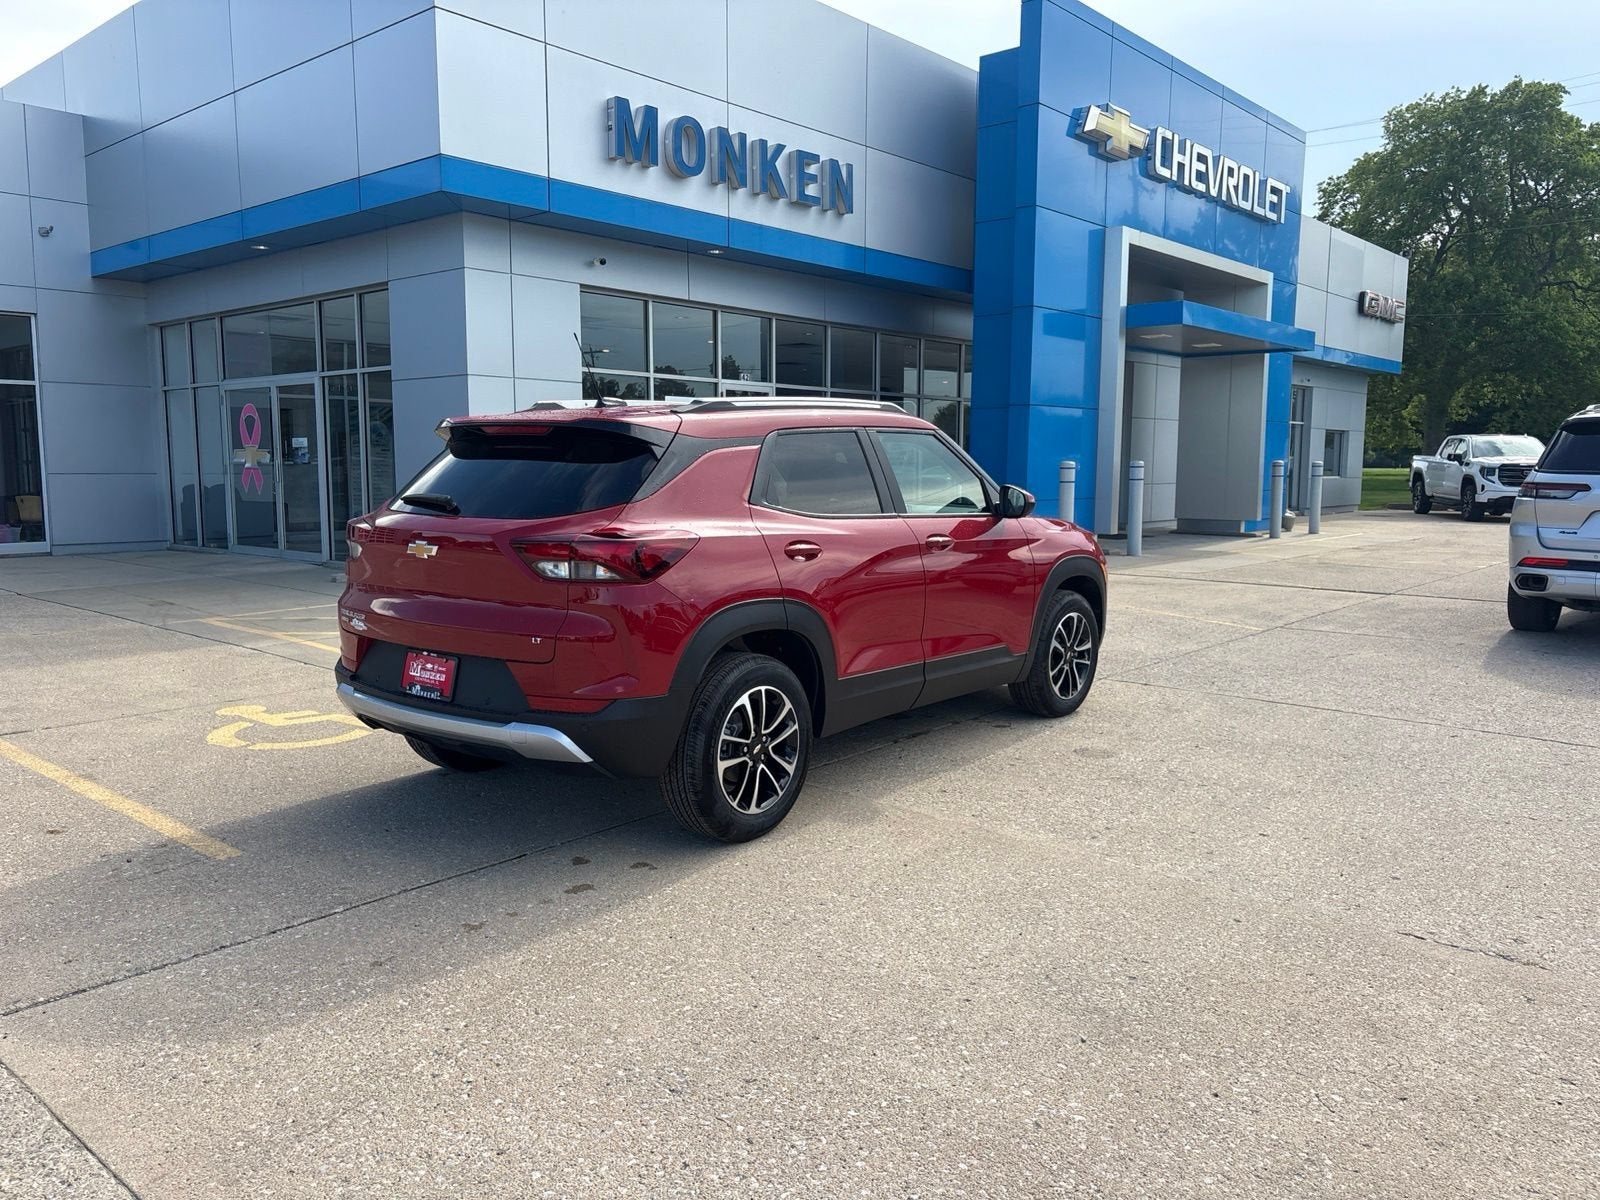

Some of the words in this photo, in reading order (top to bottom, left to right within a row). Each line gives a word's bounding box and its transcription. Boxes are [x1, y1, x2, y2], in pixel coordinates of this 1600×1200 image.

[607, 95, 854, 215] MONKEN
[1149, 125, 1291, 224] CHEVROLET
[1360, 290, 1406, 323] GMC
